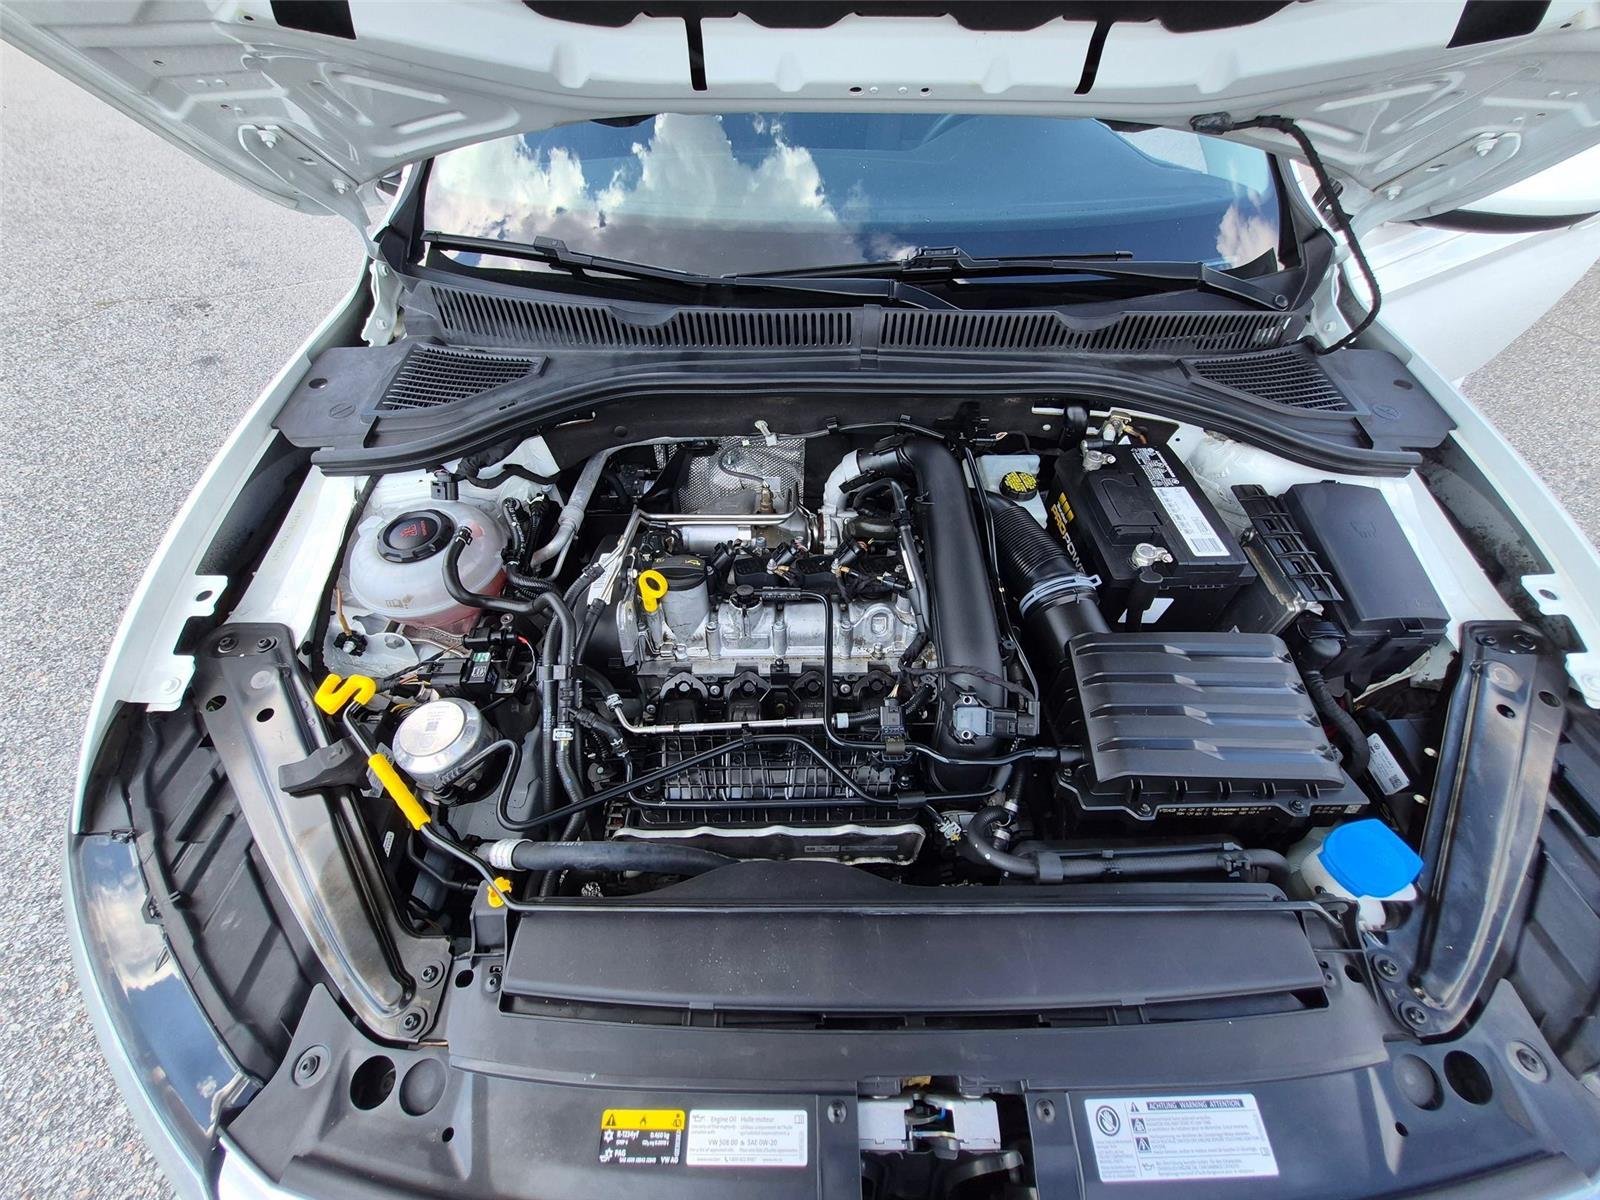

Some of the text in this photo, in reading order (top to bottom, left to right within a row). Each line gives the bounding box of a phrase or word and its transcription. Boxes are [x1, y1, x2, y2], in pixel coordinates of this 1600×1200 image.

[1050, 503, 1086, 575] PROPOWE
[1180, 1101, 1207, 1109] WARNING
[1209, 1099, 1241, 1108] ATTENTION
